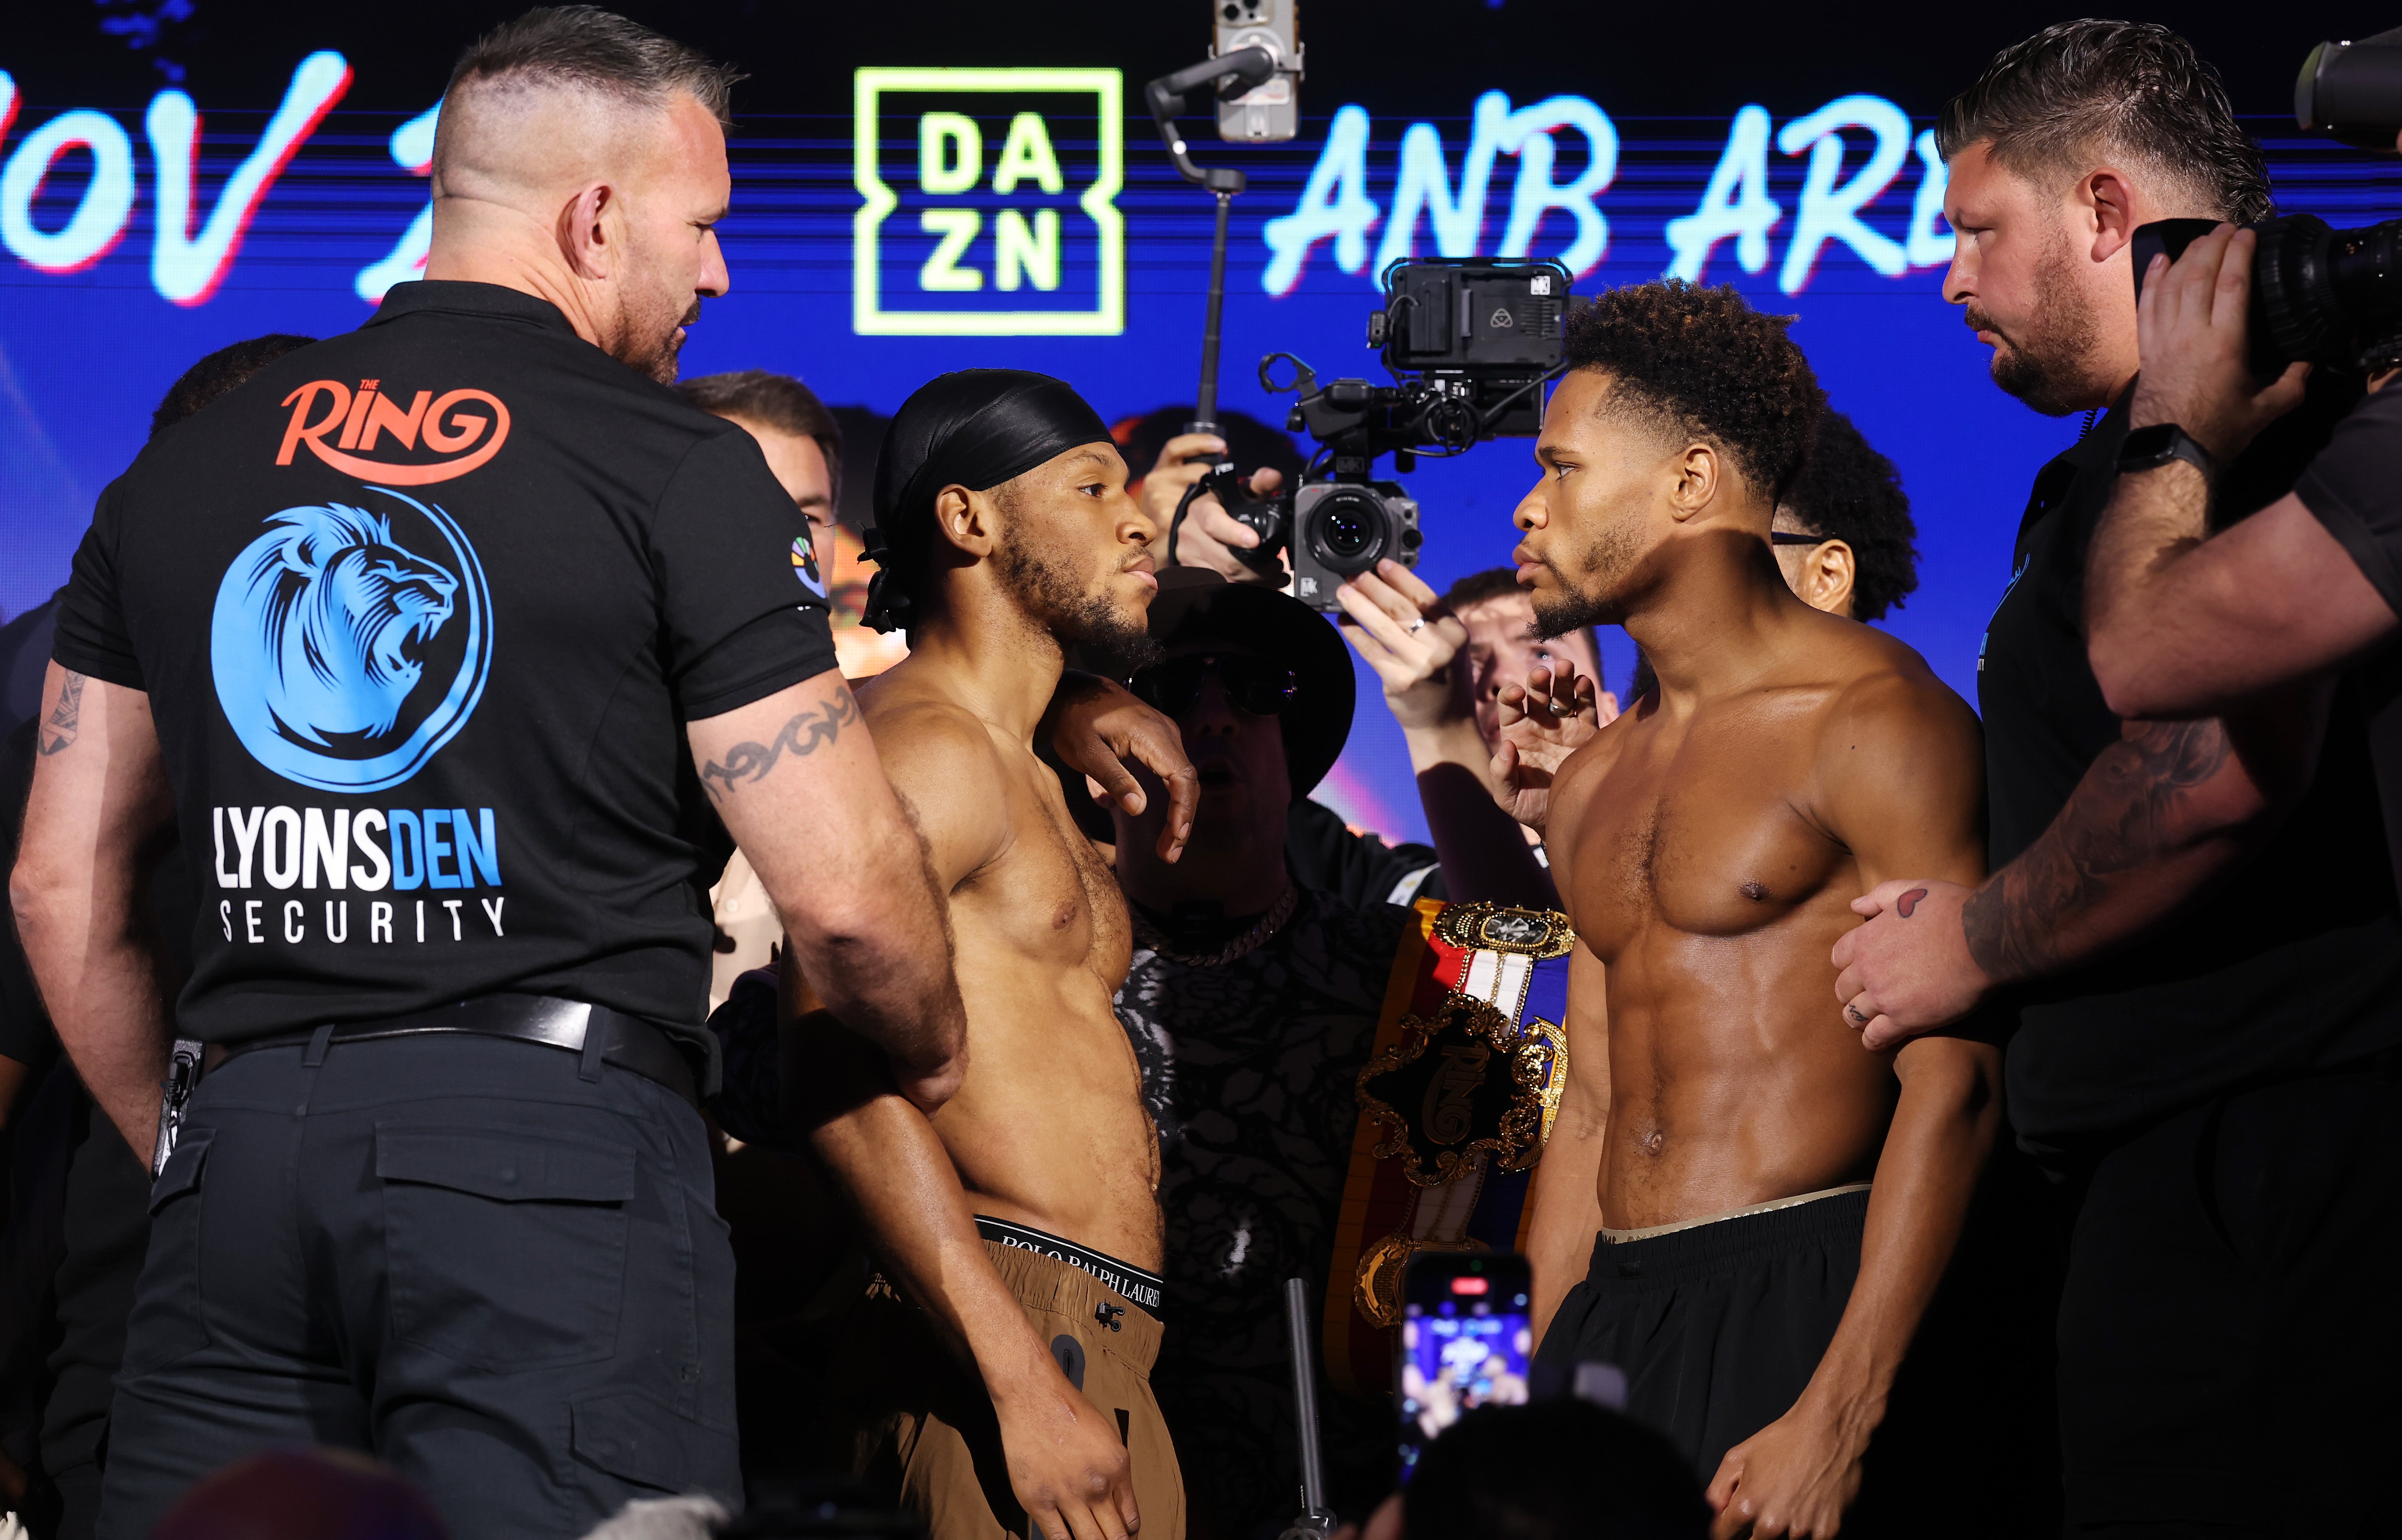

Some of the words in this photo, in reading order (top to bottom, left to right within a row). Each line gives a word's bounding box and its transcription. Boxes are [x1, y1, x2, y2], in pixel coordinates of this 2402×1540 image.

[0, 49, 354, 308] OV
[919, 111, 1064, 195] DA
[1261, 89, 1621, 298] ANB
[919, 207, 1061, 292] ZN
[360, 378, 381, 390] THE
[275, 379, 511, 486] RING
[213, 805, 503, 892] LYONSDEN
[220, 896, 505, 943] SECURITY
[1068, 1254, 1121, 1293] RALPH
